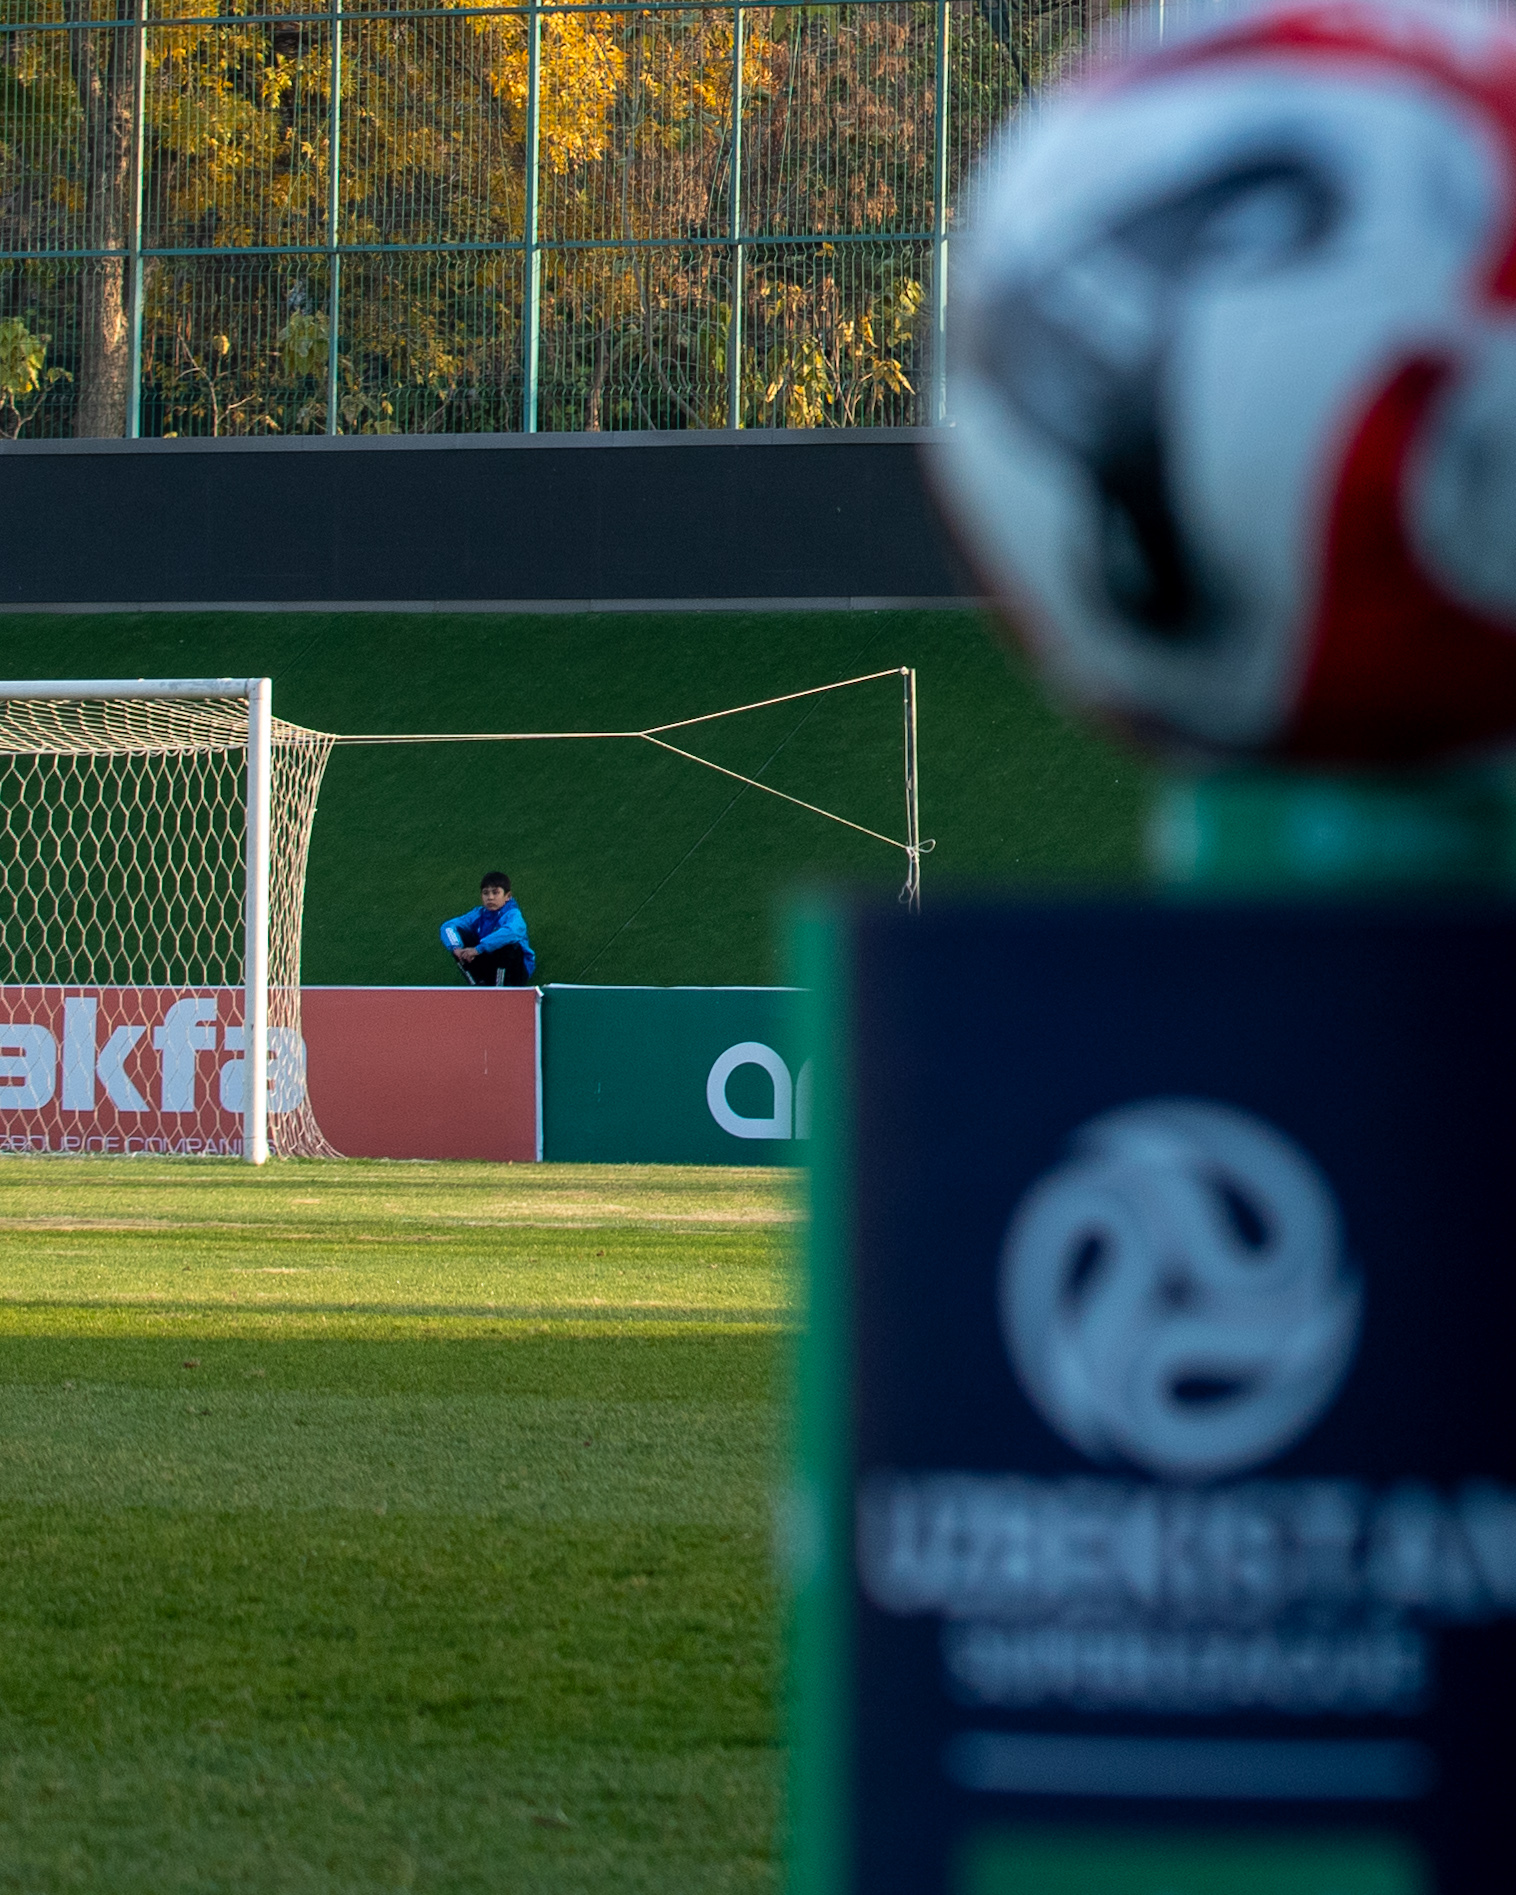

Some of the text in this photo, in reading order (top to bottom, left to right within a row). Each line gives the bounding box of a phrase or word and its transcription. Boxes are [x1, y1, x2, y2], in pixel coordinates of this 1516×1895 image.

[0, 996, 308, 1114] akfa
[86, 1135, 120, 1155] OF
[124, 1135, 277, 1157] COMPANIS
